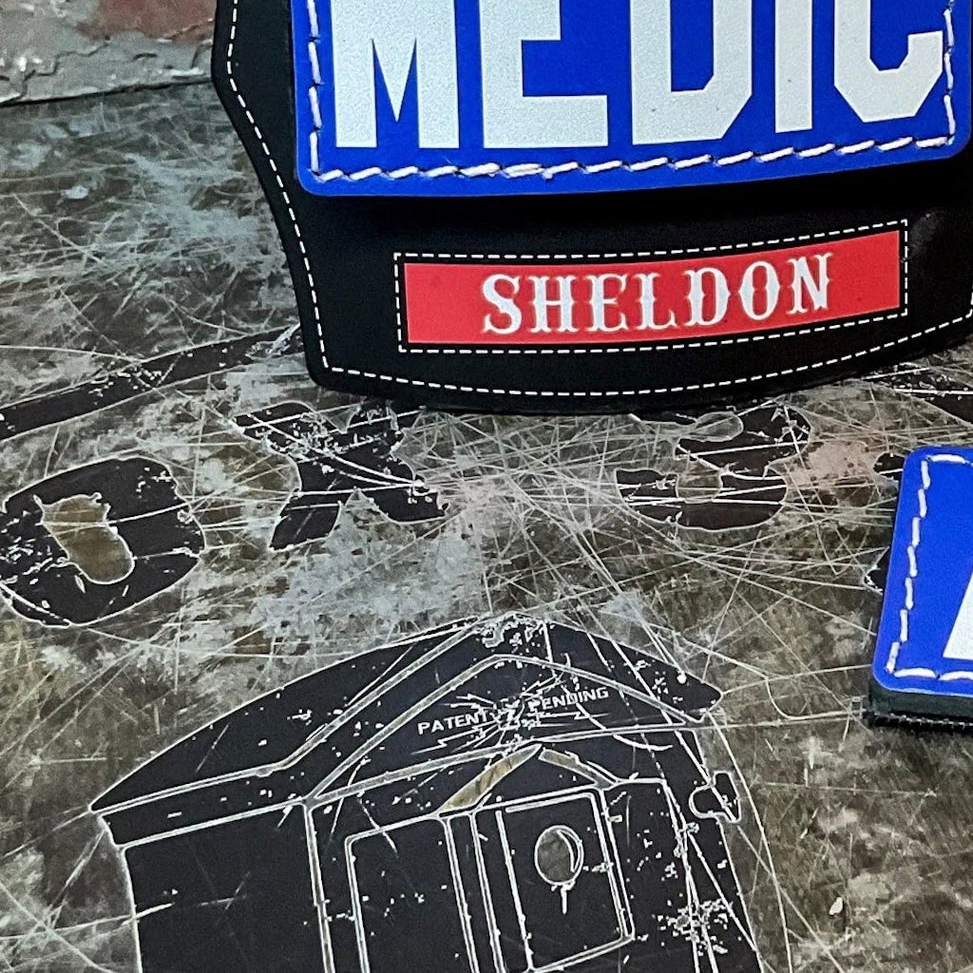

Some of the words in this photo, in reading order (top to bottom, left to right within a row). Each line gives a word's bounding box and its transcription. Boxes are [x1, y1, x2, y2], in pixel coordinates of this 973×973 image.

[481, 251, 833, 336] SHELDON
[417, 709, 490, 735] PATENT
[528, 686, 610, 713] PENDING
